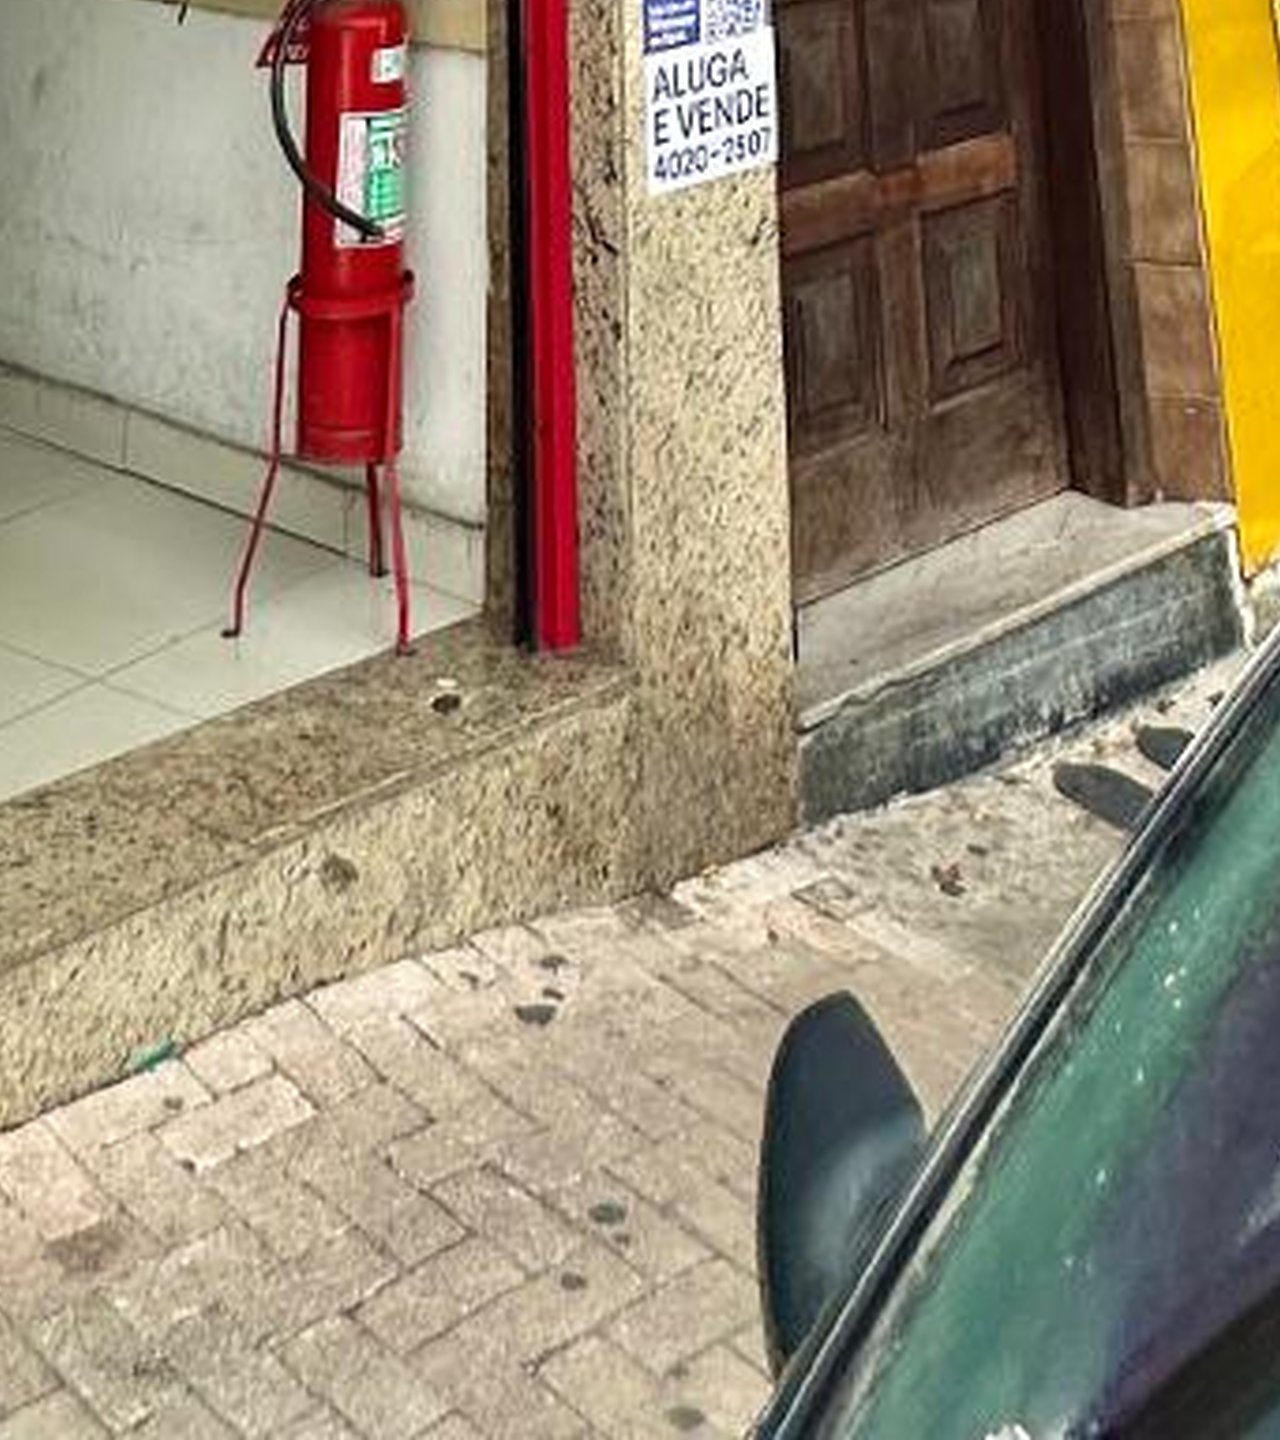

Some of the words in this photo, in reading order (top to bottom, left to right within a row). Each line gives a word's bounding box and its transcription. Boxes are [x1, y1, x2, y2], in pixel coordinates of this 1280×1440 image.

[652, 48, 751, 104] ALUGA
[654, 108, 670, 147] E
[676, 84, 770, 140] VENDE
[654, 126, 772, 181] 4020-2507
